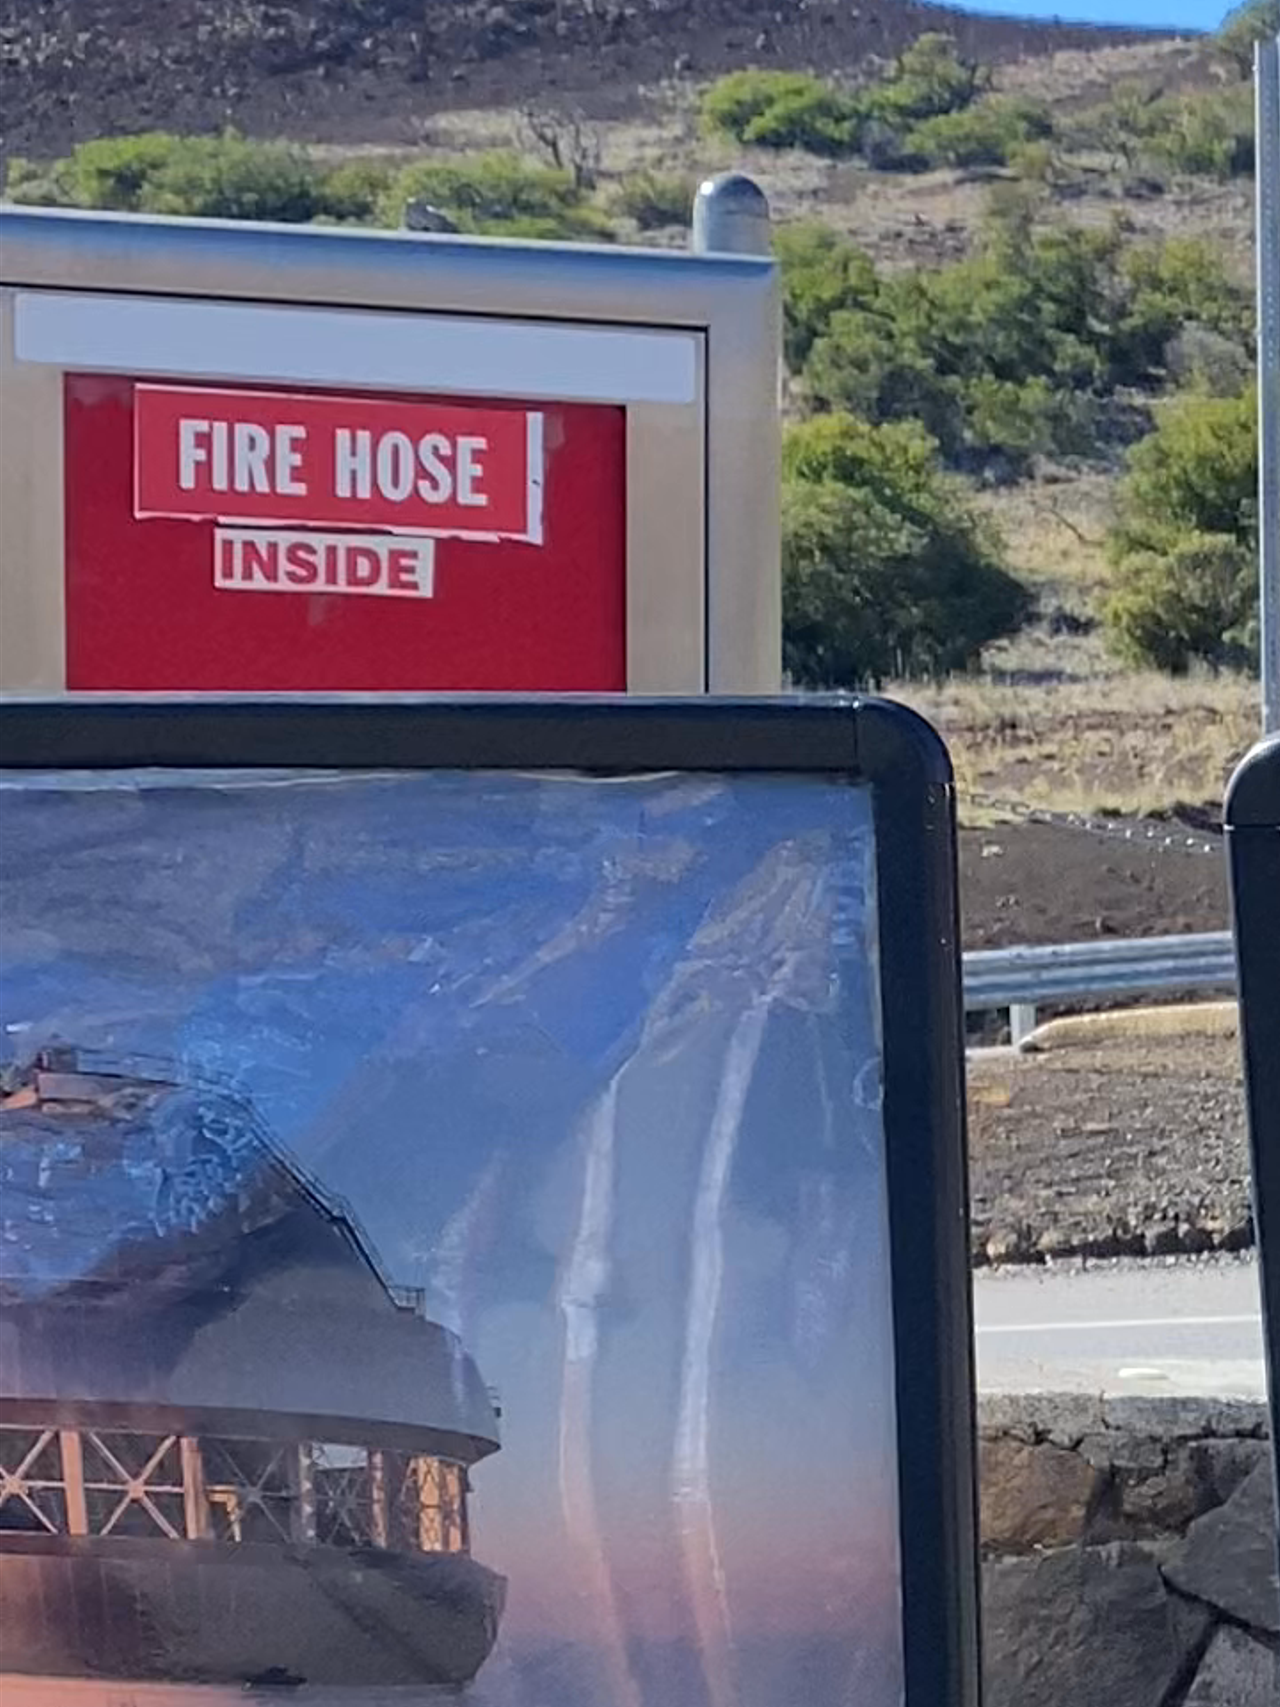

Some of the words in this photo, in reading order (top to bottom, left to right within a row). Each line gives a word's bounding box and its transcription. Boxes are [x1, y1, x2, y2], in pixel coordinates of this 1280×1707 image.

[179, 418, 307, 496] FIRE
[335, 427, 488, 506] HOSE
[221, 539, 420, 592] INSIDE
